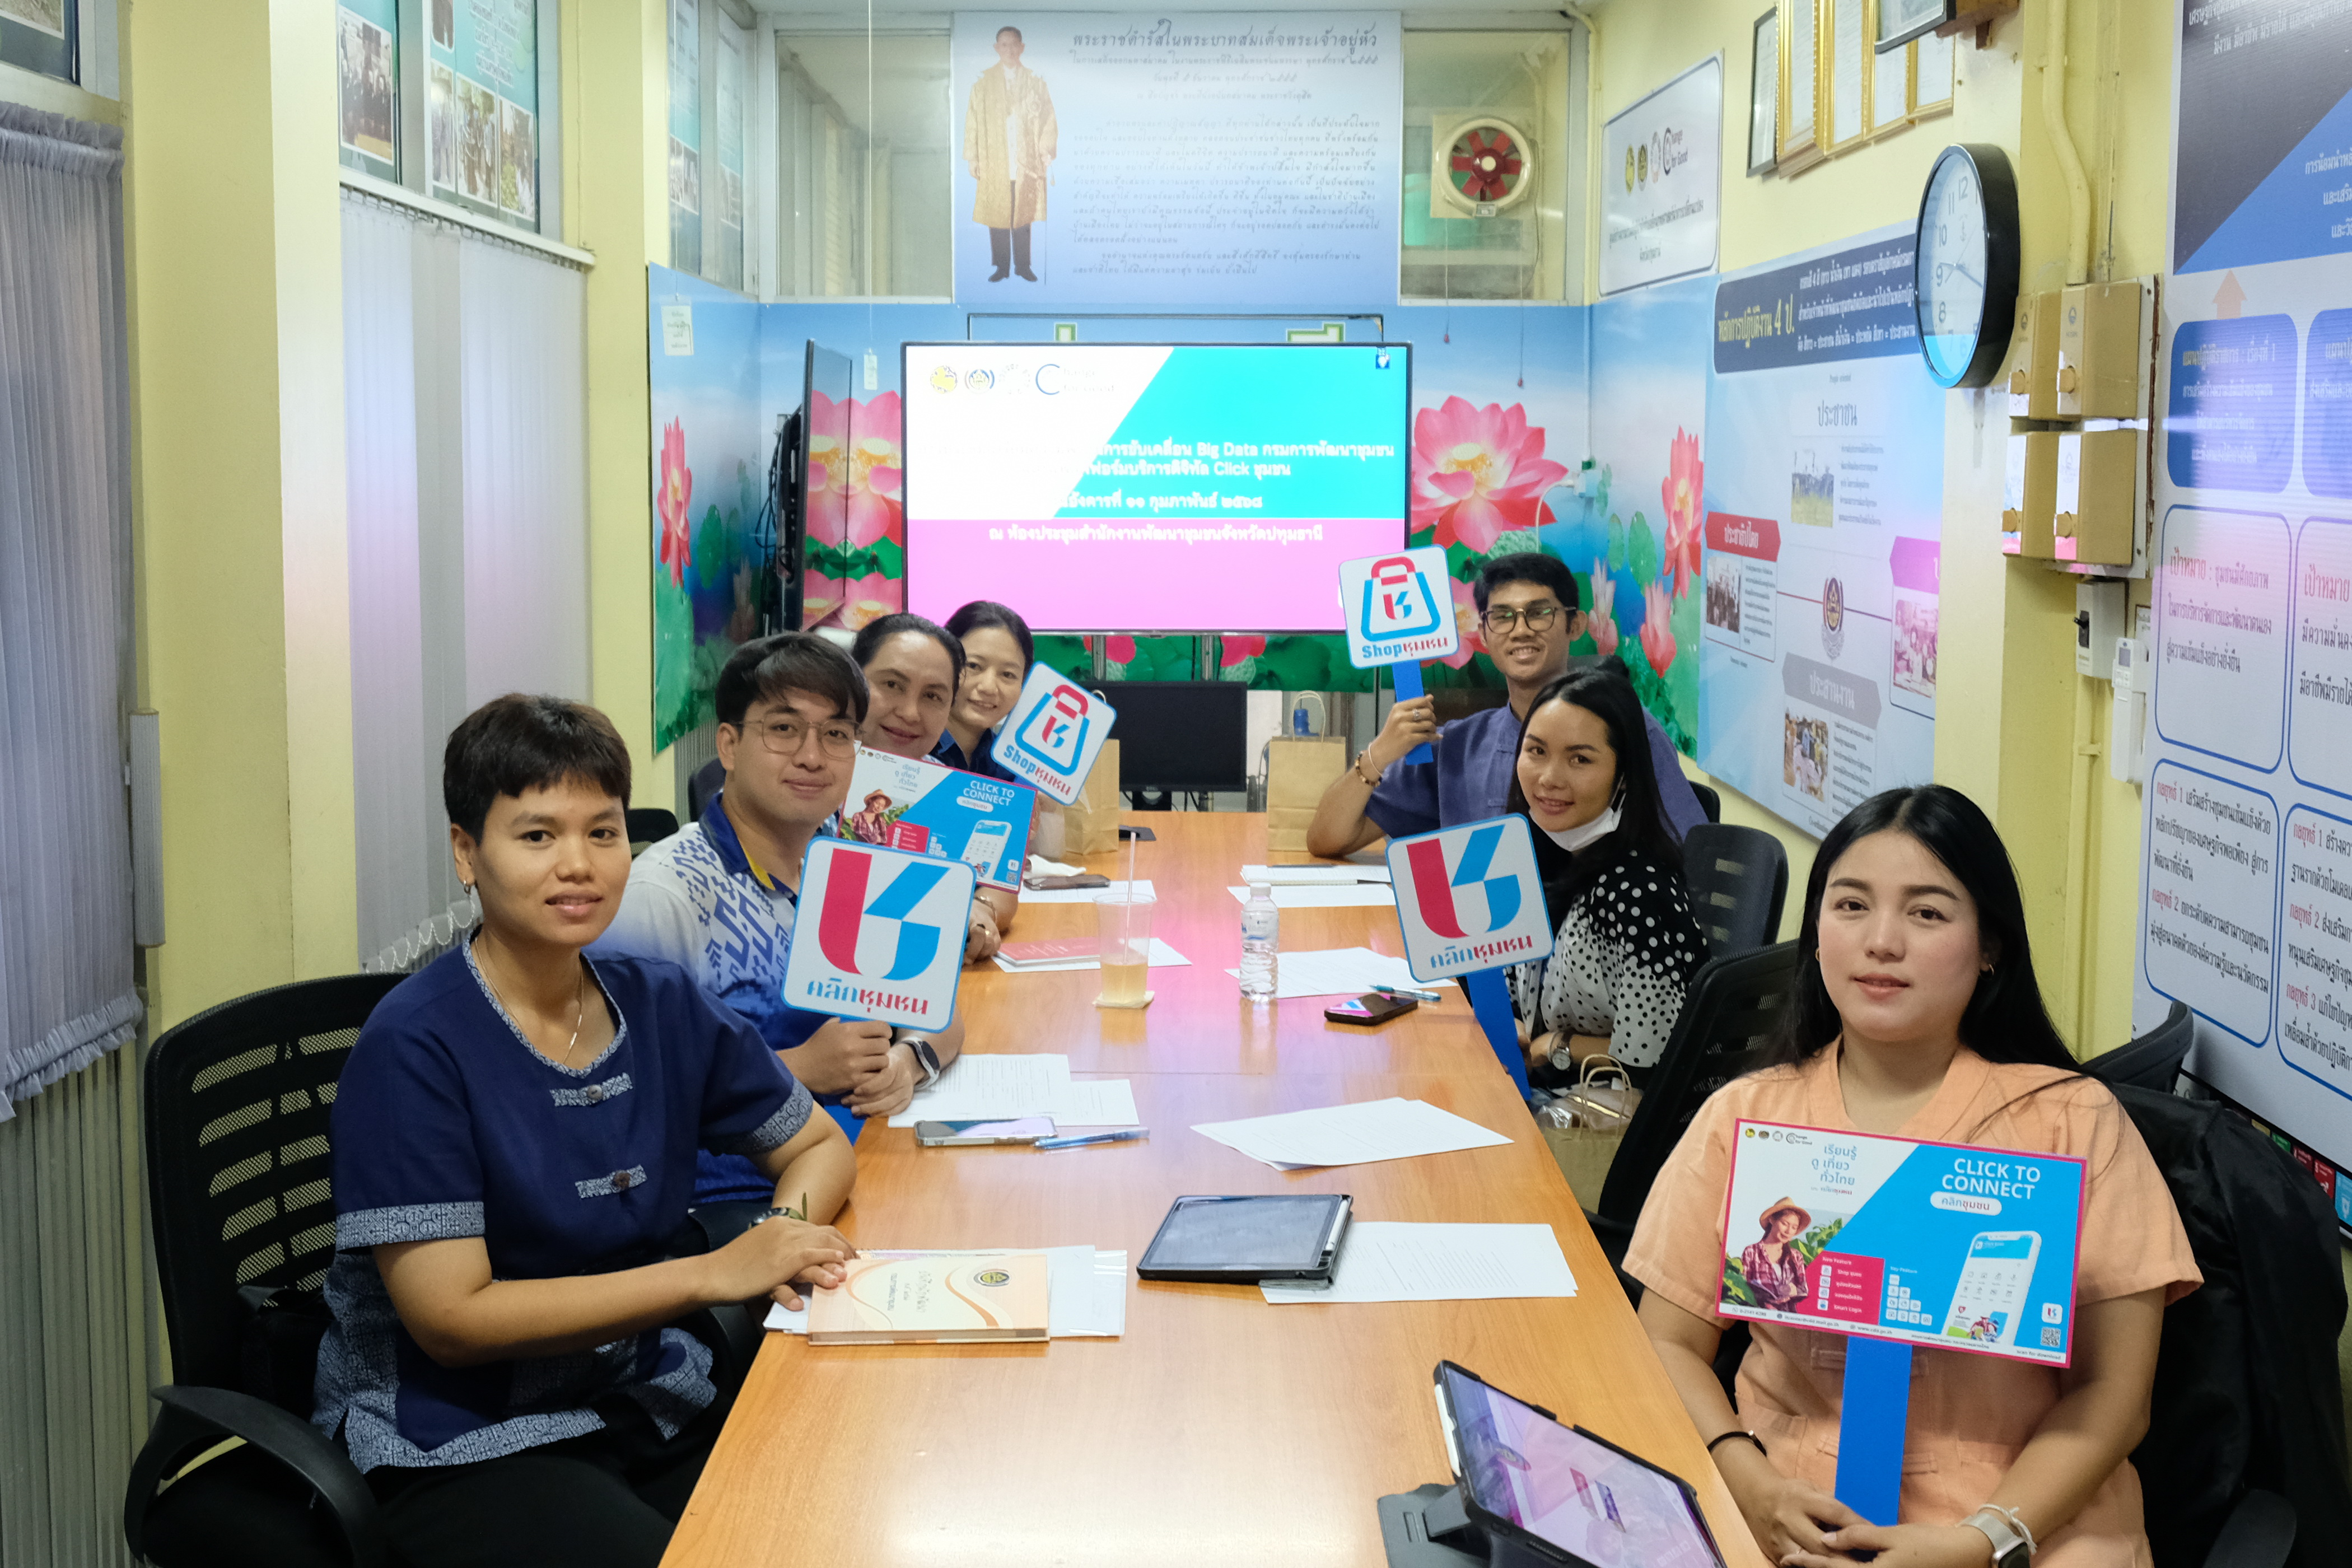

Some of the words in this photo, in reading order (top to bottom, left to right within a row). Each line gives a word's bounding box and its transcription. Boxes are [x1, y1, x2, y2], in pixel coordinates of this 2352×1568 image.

[1958, 176, 1968, 201] 12
[1948, 192, 1955, 216] 11
[1939, 223, 1948, 248] 10
[1935, 265, 1944, 287] 9
[1774, 299, 1782, 335] 4
[1938, 301, 1947, 324] 8
[1818, 400, 1858, 427] ประชาชน
[1100, 436, 1192, 457] การขับเคลื่อน
[1197, 441, 1219, 459] Big
[1224, 442, 1258, 457] Data
[1262, 440, 1394, 461] กรมการพัฒนาชุมชน
[1084, 458, 1209, 475] ฟอร์มบริการดิจิทัล
[1214, 461, 1249, 475] Click
[1254, 463, 1291, 480] ชุมชน
[1149, 491, 1218, 513] กุมภาพันธ์
[988, 528, 1004, 540] ณ
[2169, 547, 2206, 581] เป้าหมาย
[2304, 563, 2350, 603] เป้าหมาย
[963, 787, 1011, 806] CONNECT
[970, 780, 1000, 794] CLICK
[1001, 787, 1015, 798] TO
[2293, 822, 2317, 849] กลยุทธ์
[2174, 899, 2178, 912] 2
[2289, 903, 2312, 928] กลยุทธ์
[2314, 916, 2319, 929] 2
[2286, 983, 2309, 1010] กลยุทธ์
[2311, 994, 2316, 1007] 3
[1811, 1158, 1820, 1172] ดู
[1822, 1155, 1850, 1172] เที่ยว
[1823, 1144, 1858, 1161] เรียนรู้
[1819, 1169, 1856, 1186] ทั่วไทย
[1954, 1157, 2009, 1179] CLICK
[2014, 1164, 2042, 1183] TO
[1941, 1174, 2036, 1200] CONNECT
[1941, 1196, 1991, 1213] คลิกชุมชน
